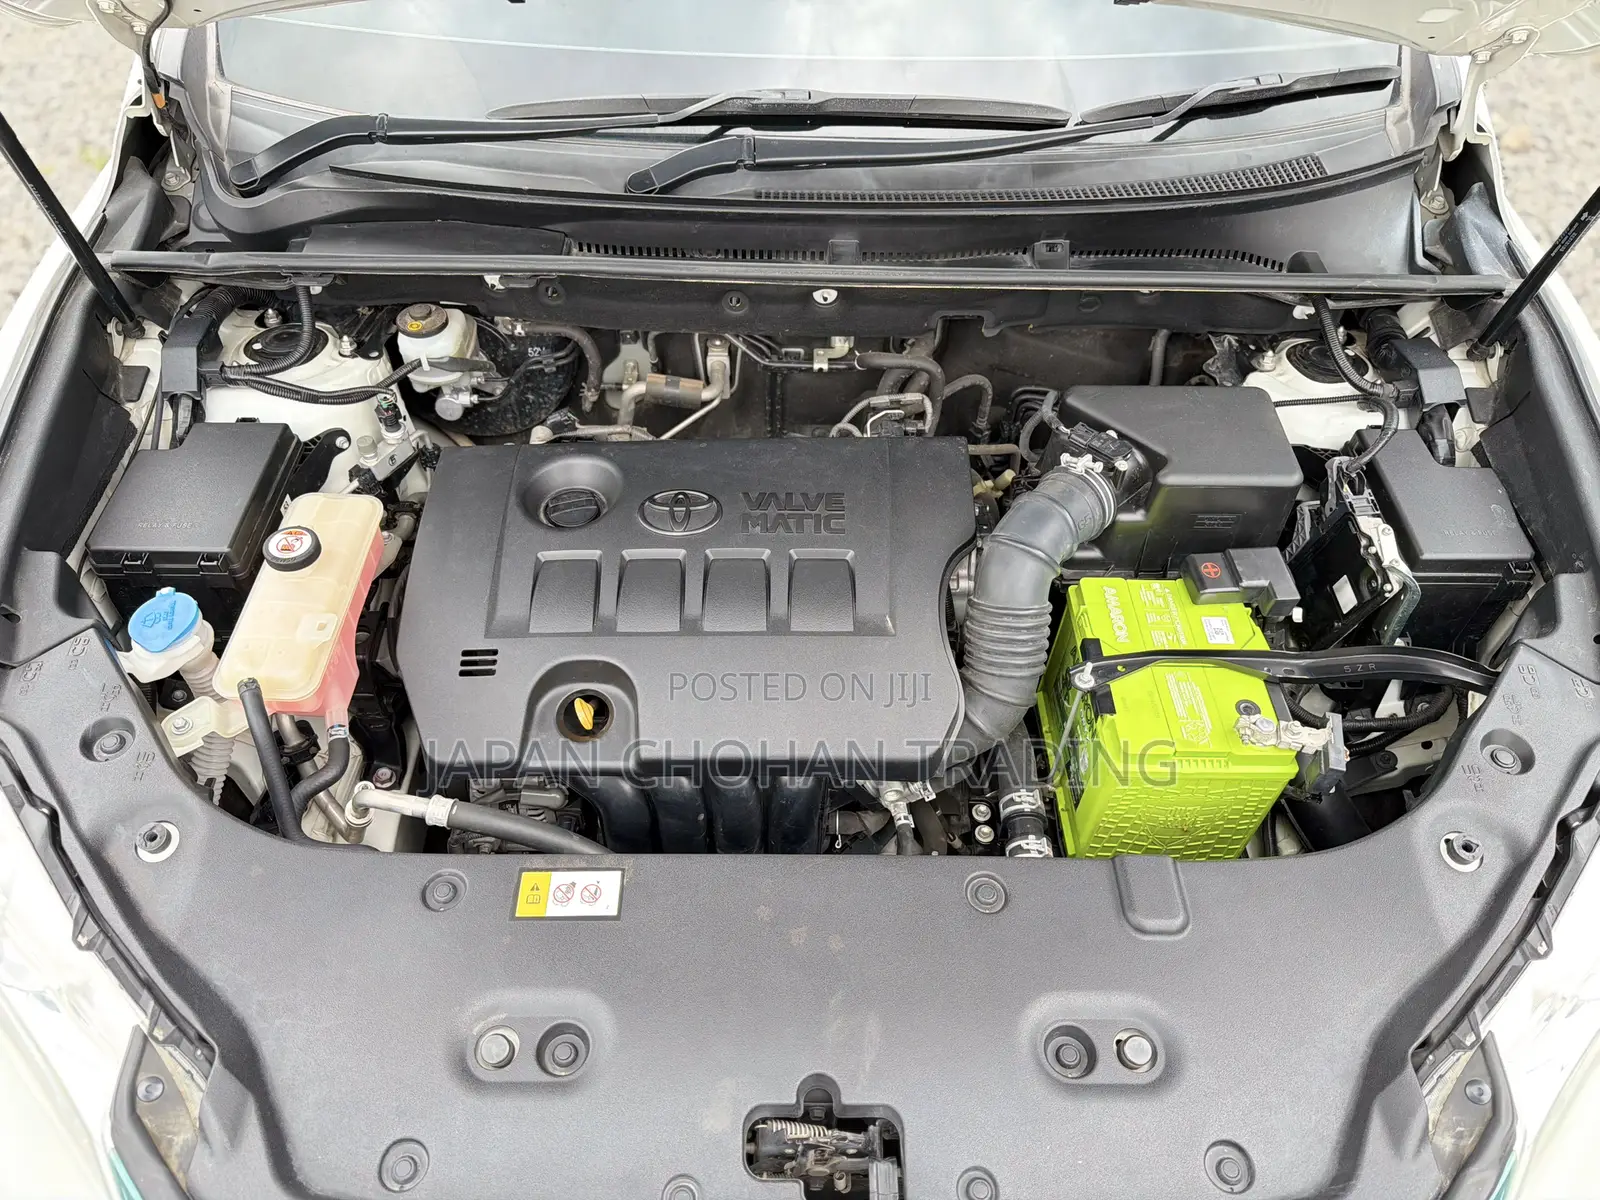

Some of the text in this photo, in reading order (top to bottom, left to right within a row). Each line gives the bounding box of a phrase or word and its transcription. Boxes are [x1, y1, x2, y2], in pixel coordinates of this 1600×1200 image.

[740, 491, 846, 512] VALVE
[740, 513, 846, 534] MATIC
[1102, 585, 1131, 643] AMARON
